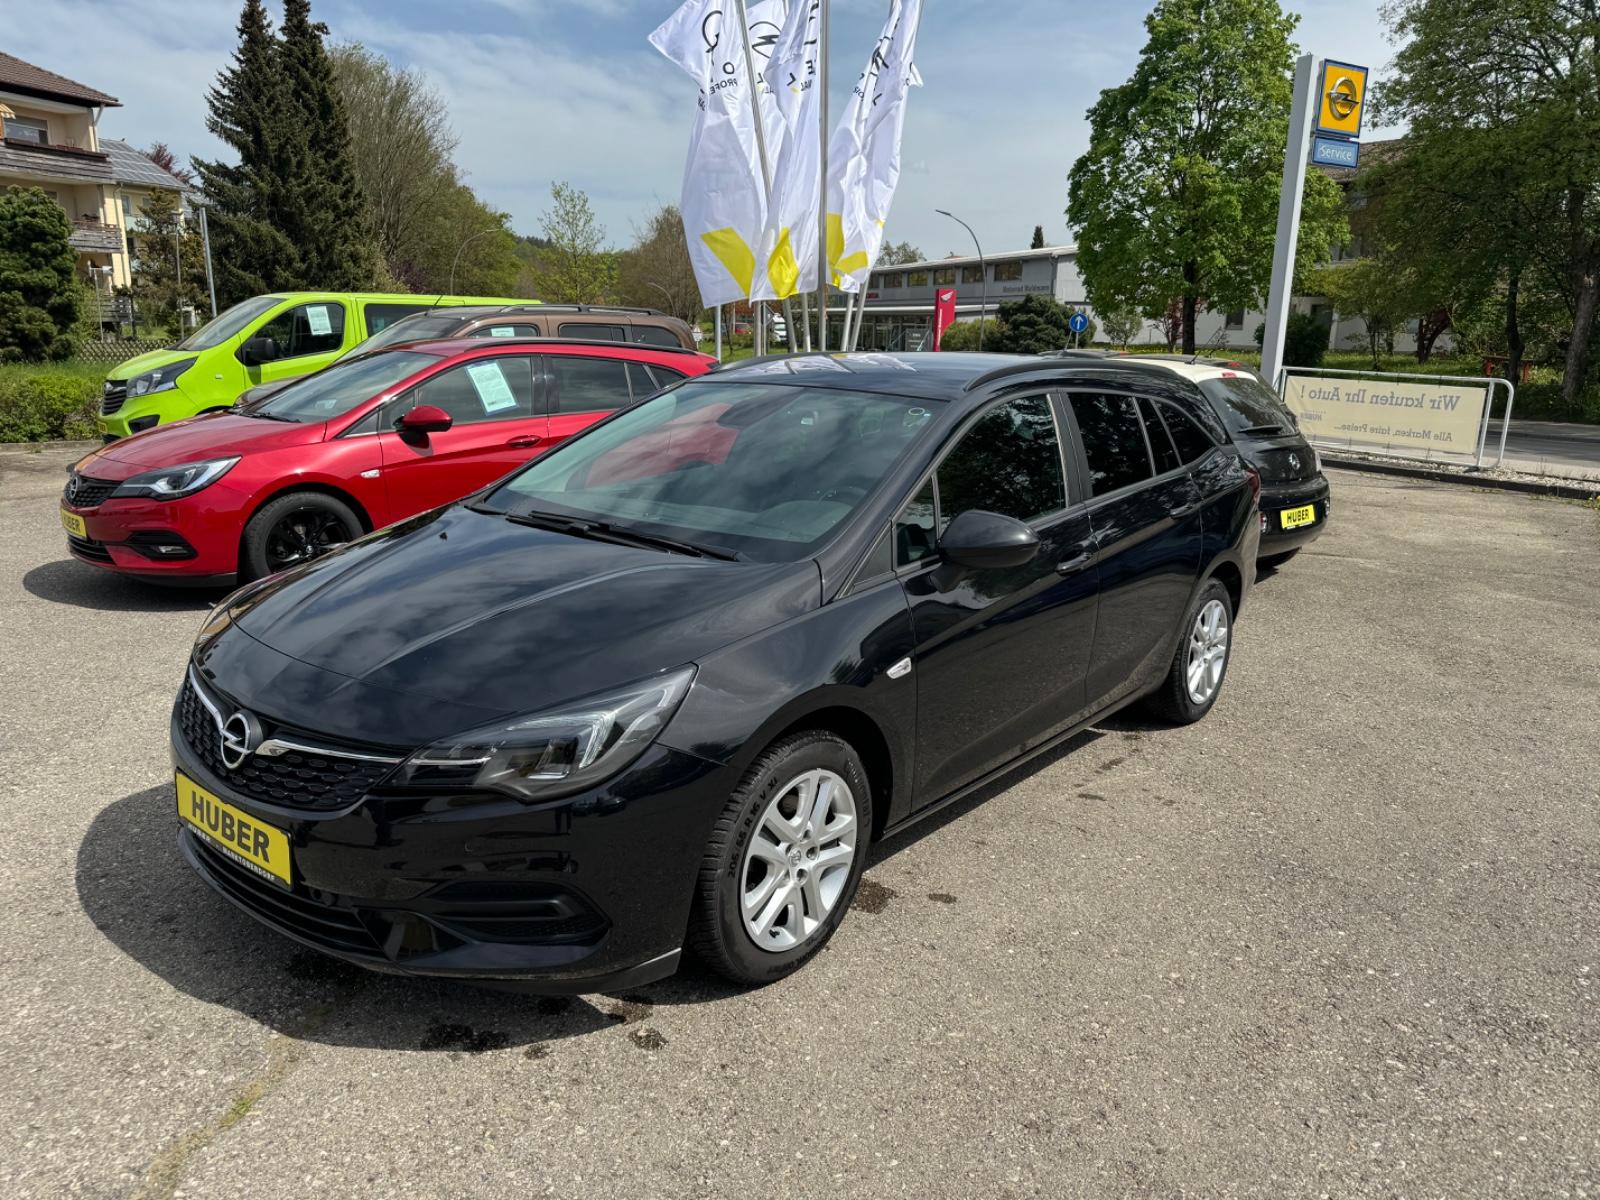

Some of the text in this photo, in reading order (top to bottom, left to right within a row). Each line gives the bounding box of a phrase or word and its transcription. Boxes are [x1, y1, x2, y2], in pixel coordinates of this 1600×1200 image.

[1319, 143, 1354, 161] Service
[1286, 508, 1310, 525] HUBER
[191, 790, 271, 864] HUBER
